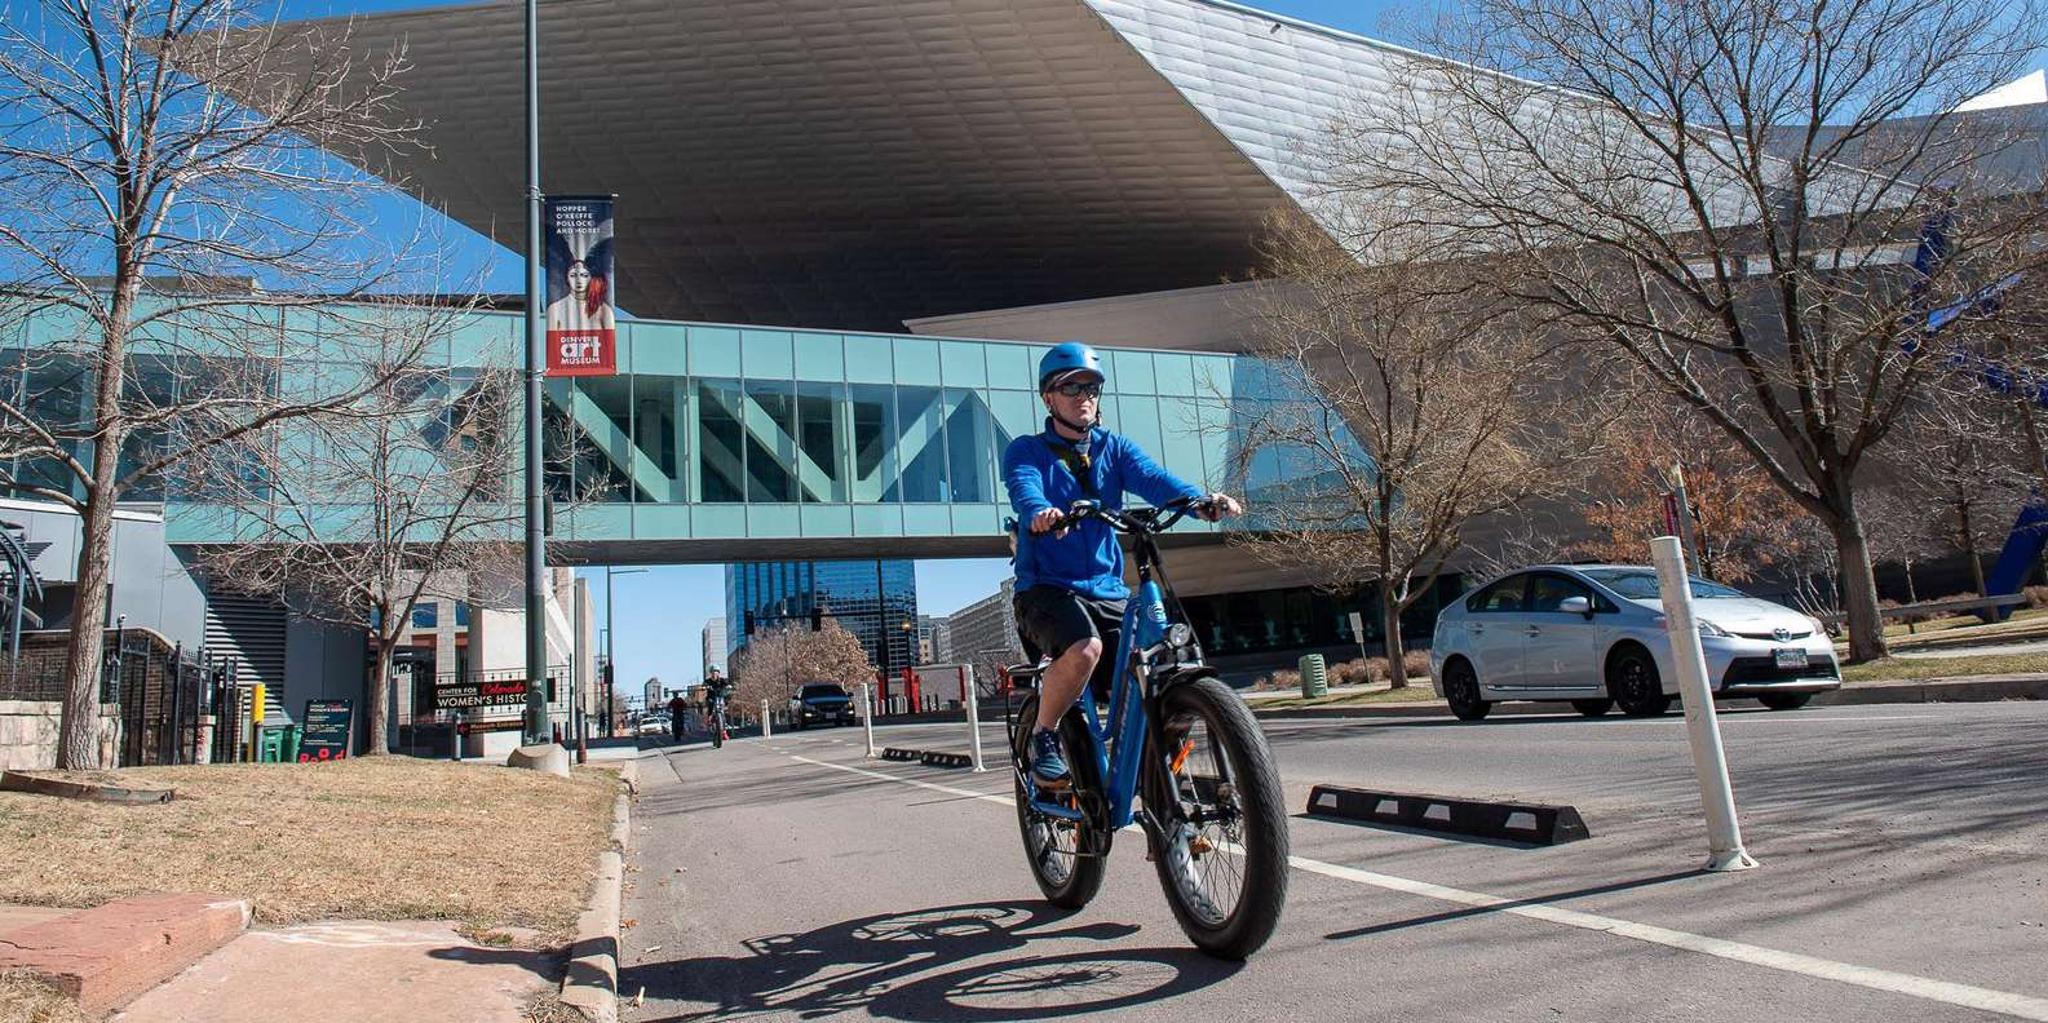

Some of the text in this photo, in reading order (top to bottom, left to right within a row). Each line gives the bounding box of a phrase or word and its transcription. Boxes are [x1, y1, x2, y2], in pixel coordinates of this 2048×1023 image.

[560, 336, 602, 358] art
[560, 357, 601, 365] MUSEUM
[437, 693, 528, 707] WOMEN'S HISTO
